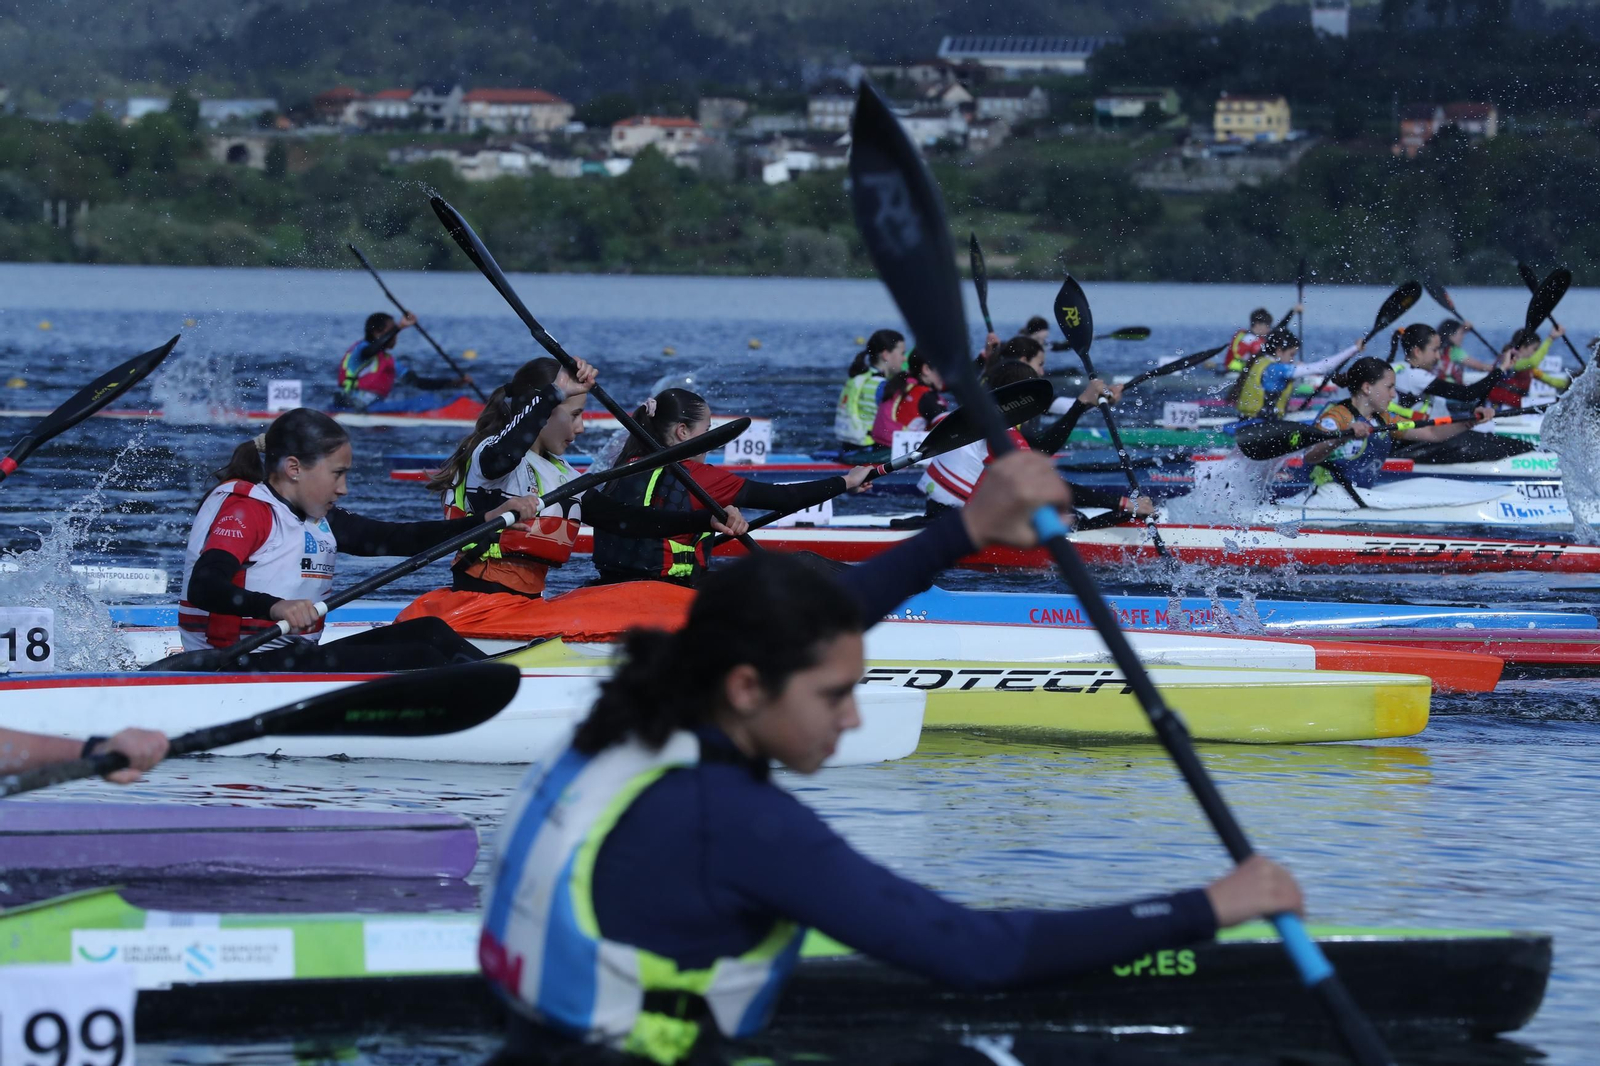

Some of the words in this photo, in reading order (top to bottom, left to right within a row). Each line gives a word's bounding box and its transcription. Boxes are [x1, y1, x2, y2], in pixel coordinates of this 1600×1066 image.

[273, 387, 299, 400] 205
[732, 439, 766, 456] 189
[1029, 608, 1086, 624] CANAL
[860, 668, 1148, 695] EDTECH
[0, 1008, 125, 1066] 99
